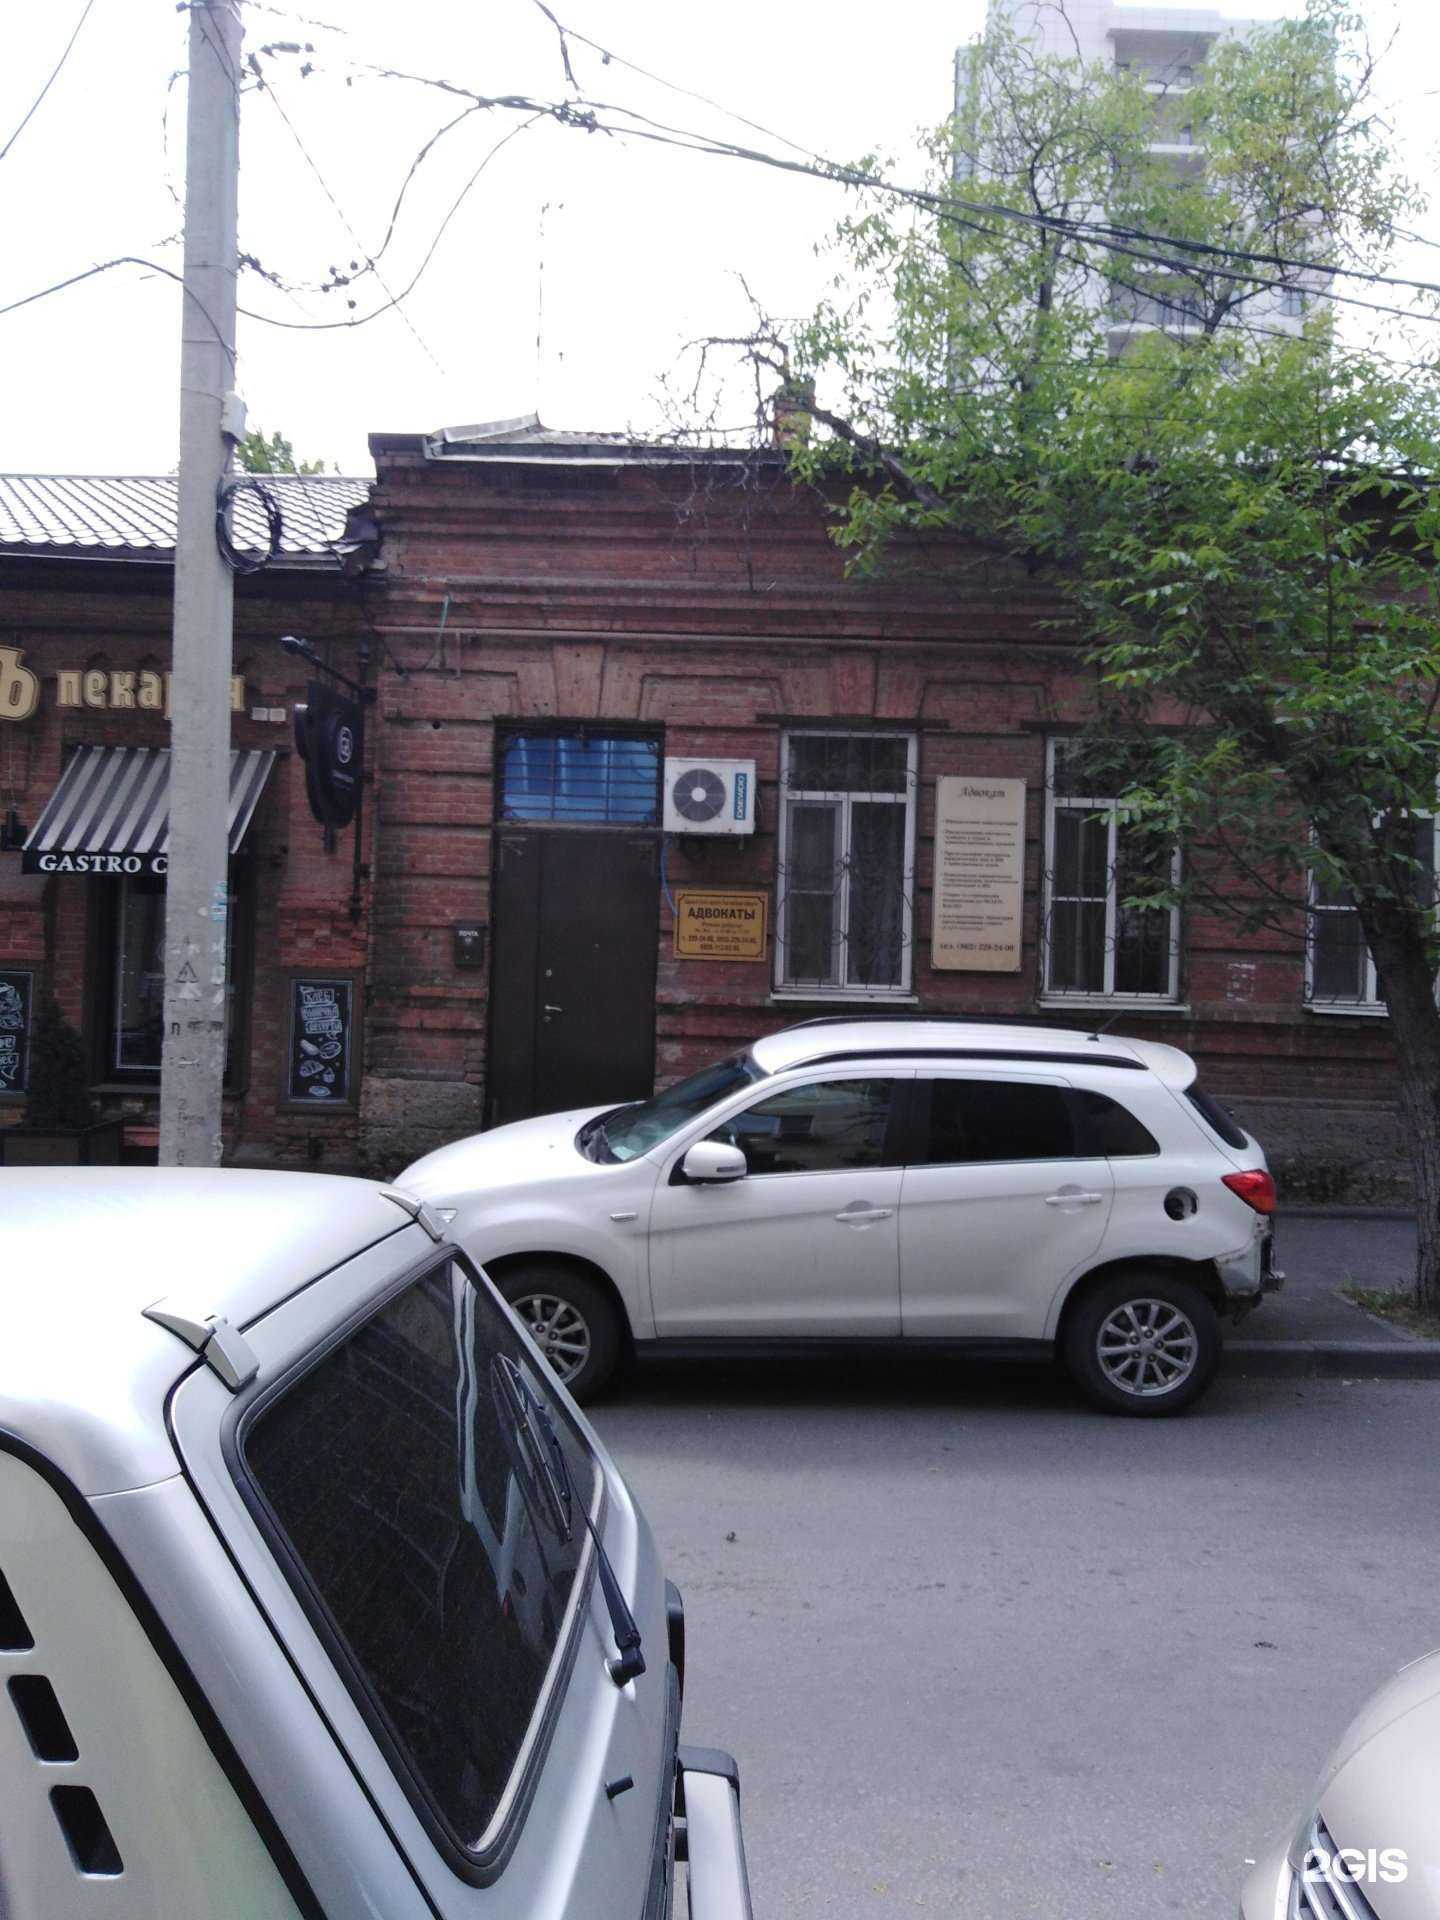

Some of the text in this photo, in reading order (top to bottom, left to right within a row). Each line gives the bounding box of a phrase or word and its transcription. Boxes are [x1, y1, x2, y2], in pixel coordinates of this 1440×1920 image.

[736, 774, 746, 819] DAEWOO
[957, 785, 1007, 800] Адвокат
[38, 854, 142, 873] GASTRO
[687, 906, 756, 920] АДВОКАТЫ
